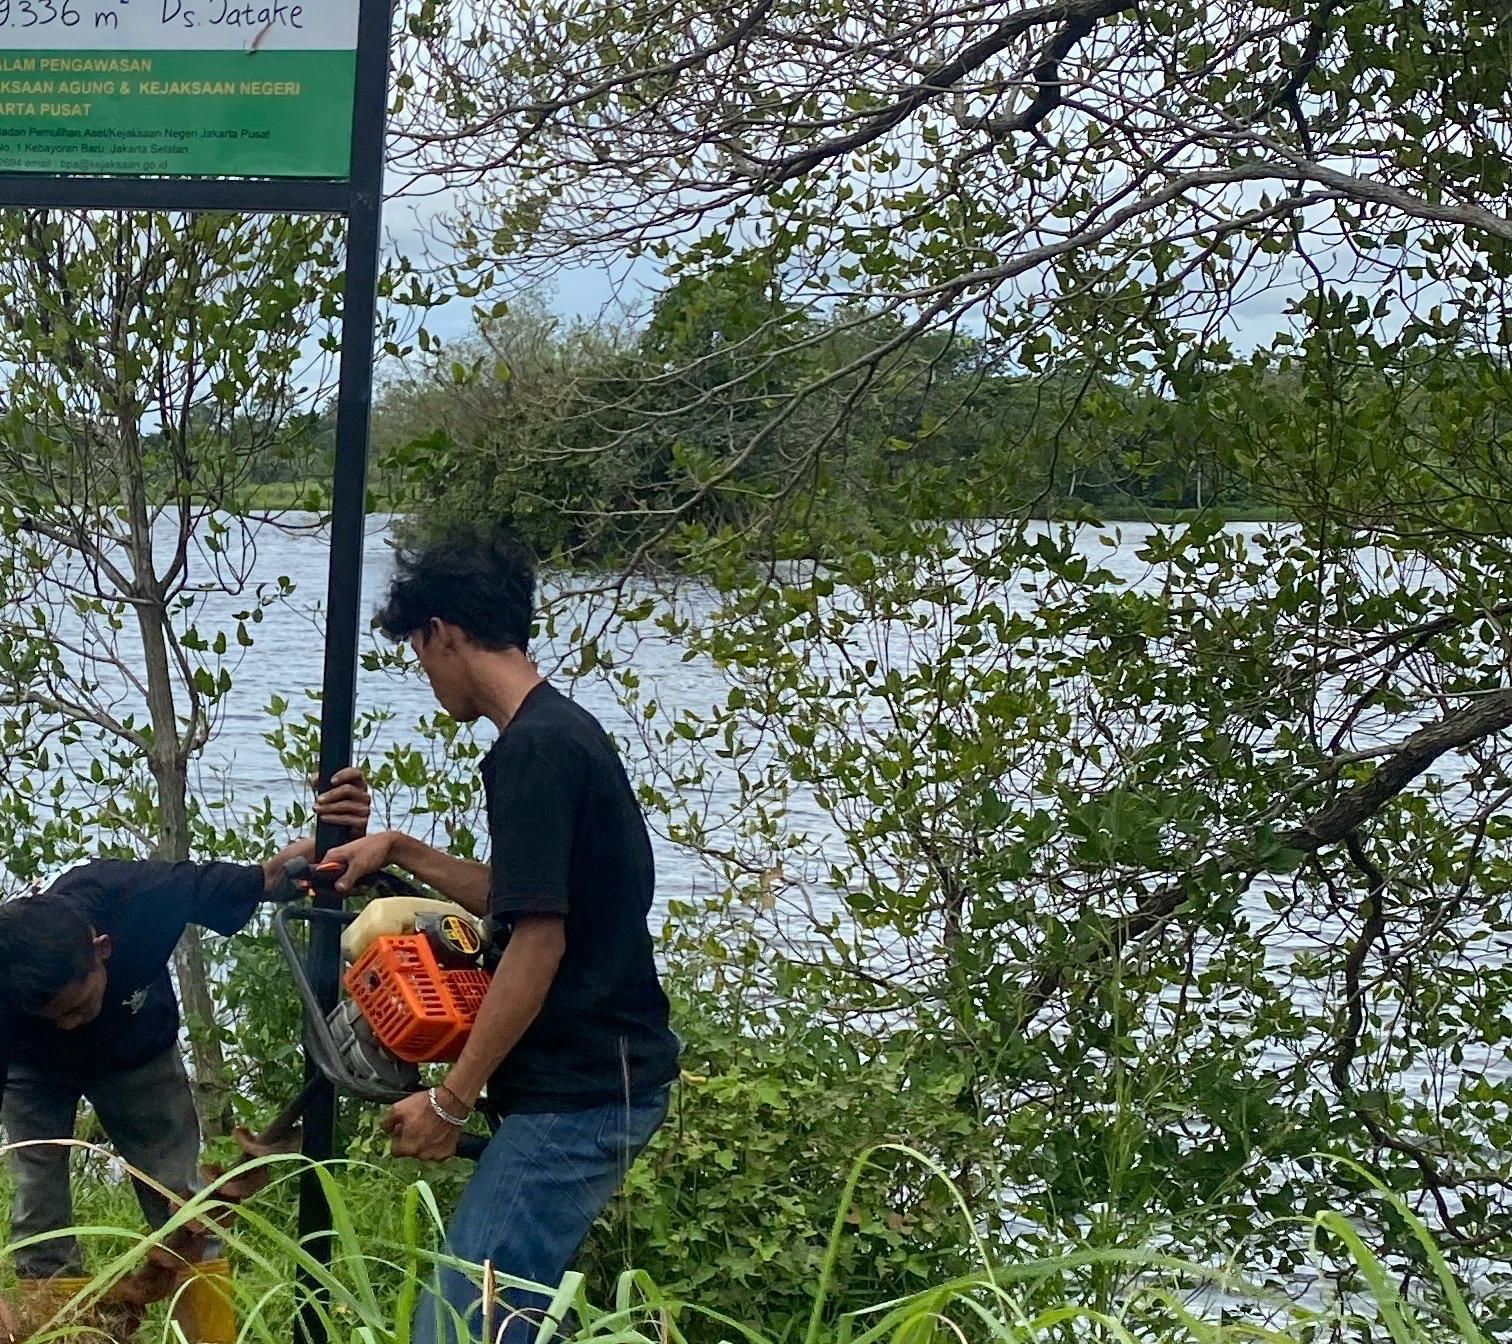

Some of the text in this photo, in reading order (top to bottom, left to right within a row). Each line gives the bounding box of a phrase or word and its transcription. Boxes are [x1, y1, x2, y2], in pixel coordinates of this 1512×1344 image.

[40, 58, 152, 73] PENGAWASAN
[58, 81, 115, 95] AGUNG
[119, 81, 131, 95] &
[139, 81, 236, 96] KEJAKSAAN
[240, 81, 301, 96] NEGERI
[40, 103, 92, 117] PUSAT
